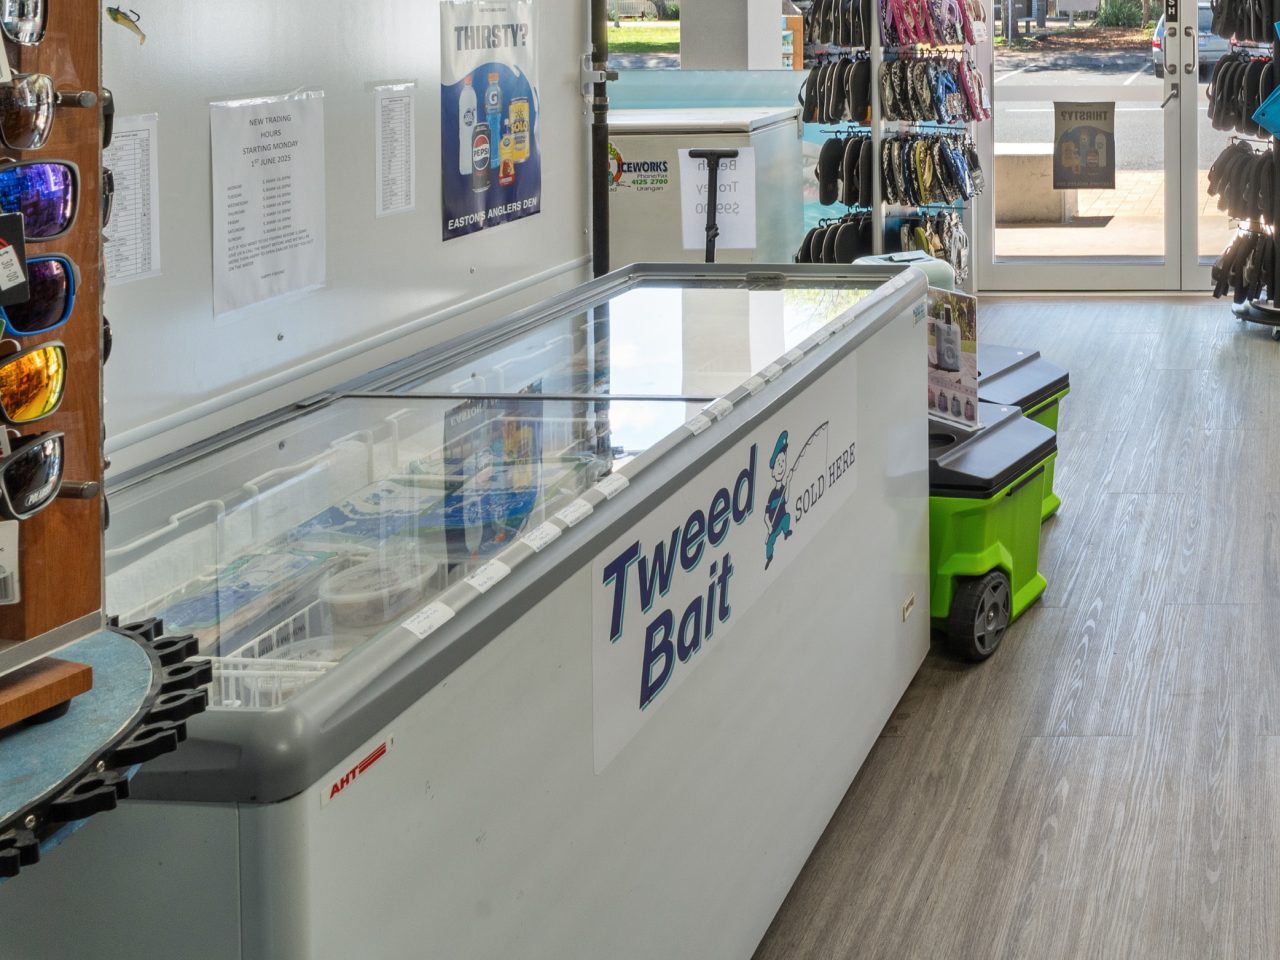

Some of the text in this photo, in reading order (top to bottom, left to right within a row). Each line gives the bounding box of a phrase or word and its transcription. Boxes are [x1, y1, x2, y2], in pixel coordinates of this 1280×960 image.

[454, 23, 528, 51] THIRSTY?
[249, 114, 292, 126] NEW TRADING
[260, 129, 281, 138] HOURS
[242, 140, 299, 155] STARTING MONDAY
[260, 156, 276, 166] JUNE
[277, 154, 292, 163] 2025
[473, 147, 490, 158] PEPSI
[447, 195, 537, 230] EASTON'S ANGLERS DEN
[795, 442, 856, 523] SOLD HERE
[603, 442, 759, 645] Tweed
[639, 552, 733, 712] Bait
[329, 765, 359, 800] AHT
